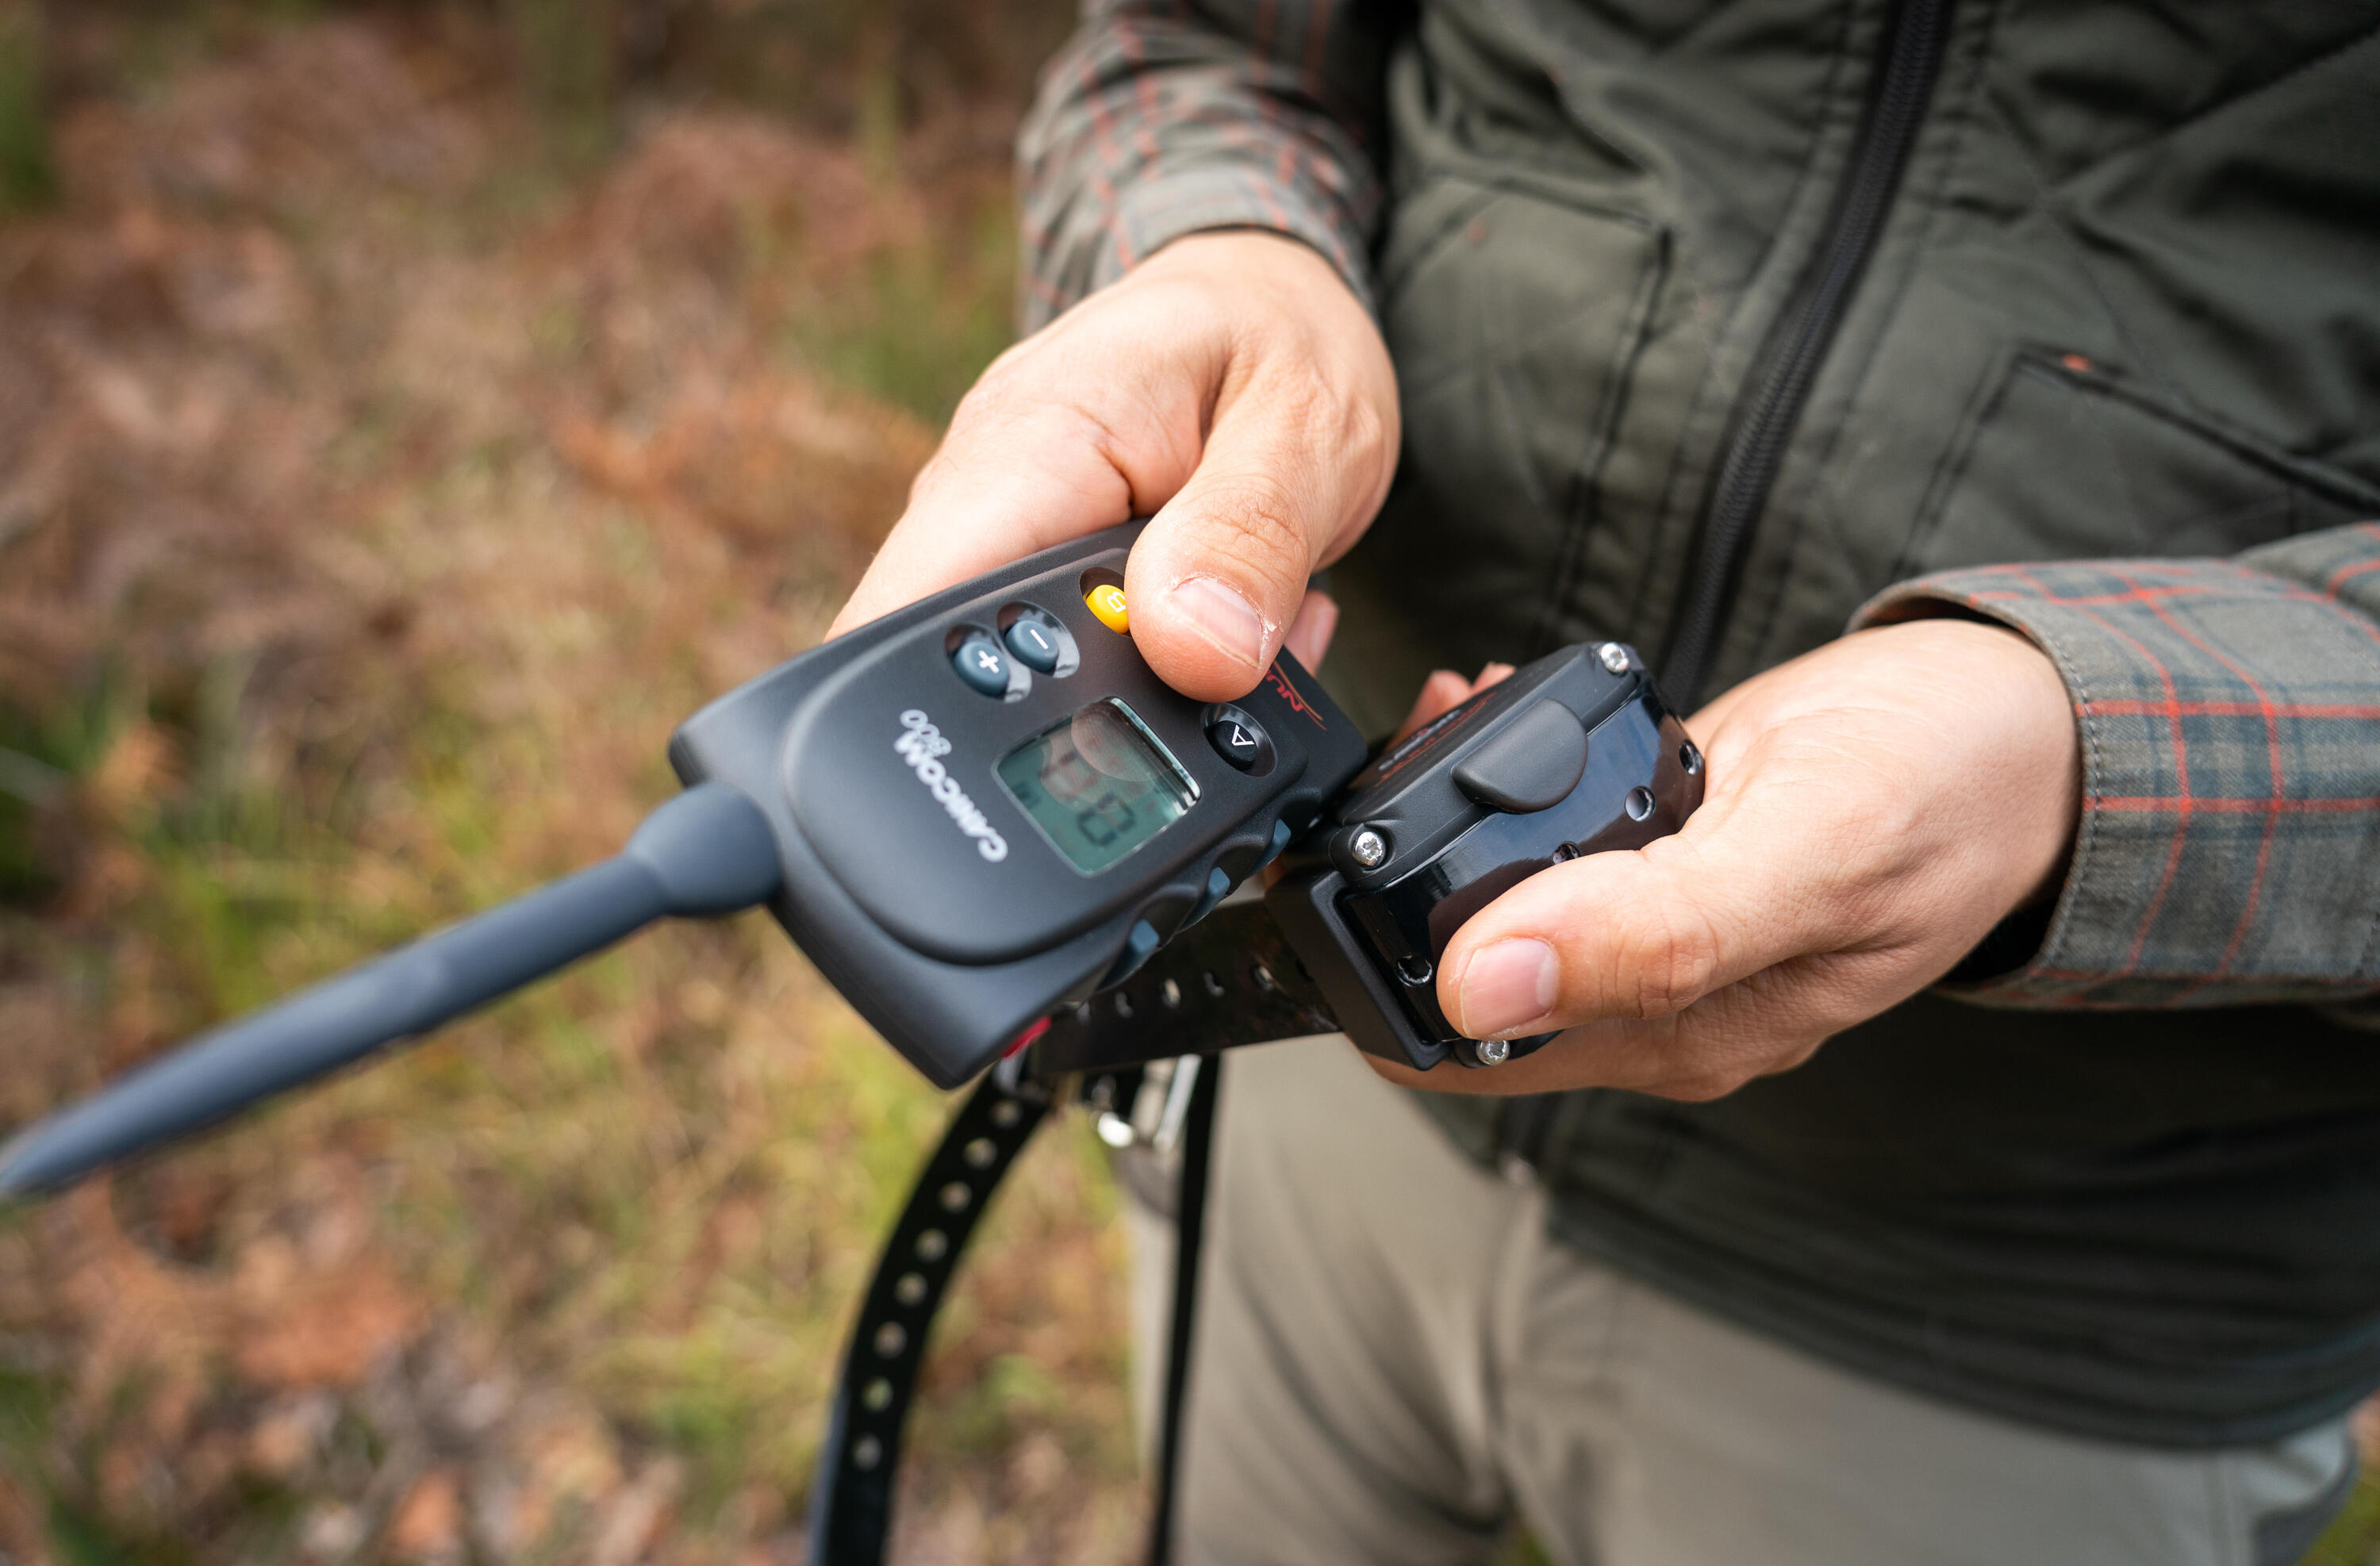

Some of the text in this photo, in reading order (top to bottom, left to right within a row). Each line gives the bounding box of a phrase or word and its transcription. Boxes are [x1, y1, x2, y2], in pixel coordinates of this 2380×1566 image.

[1107, 591, 1127, 613] B
[1264, 669, 1303, 712] NU
[900, 708, 952, 755] 800
[1231, 724, 1255, 747] A
